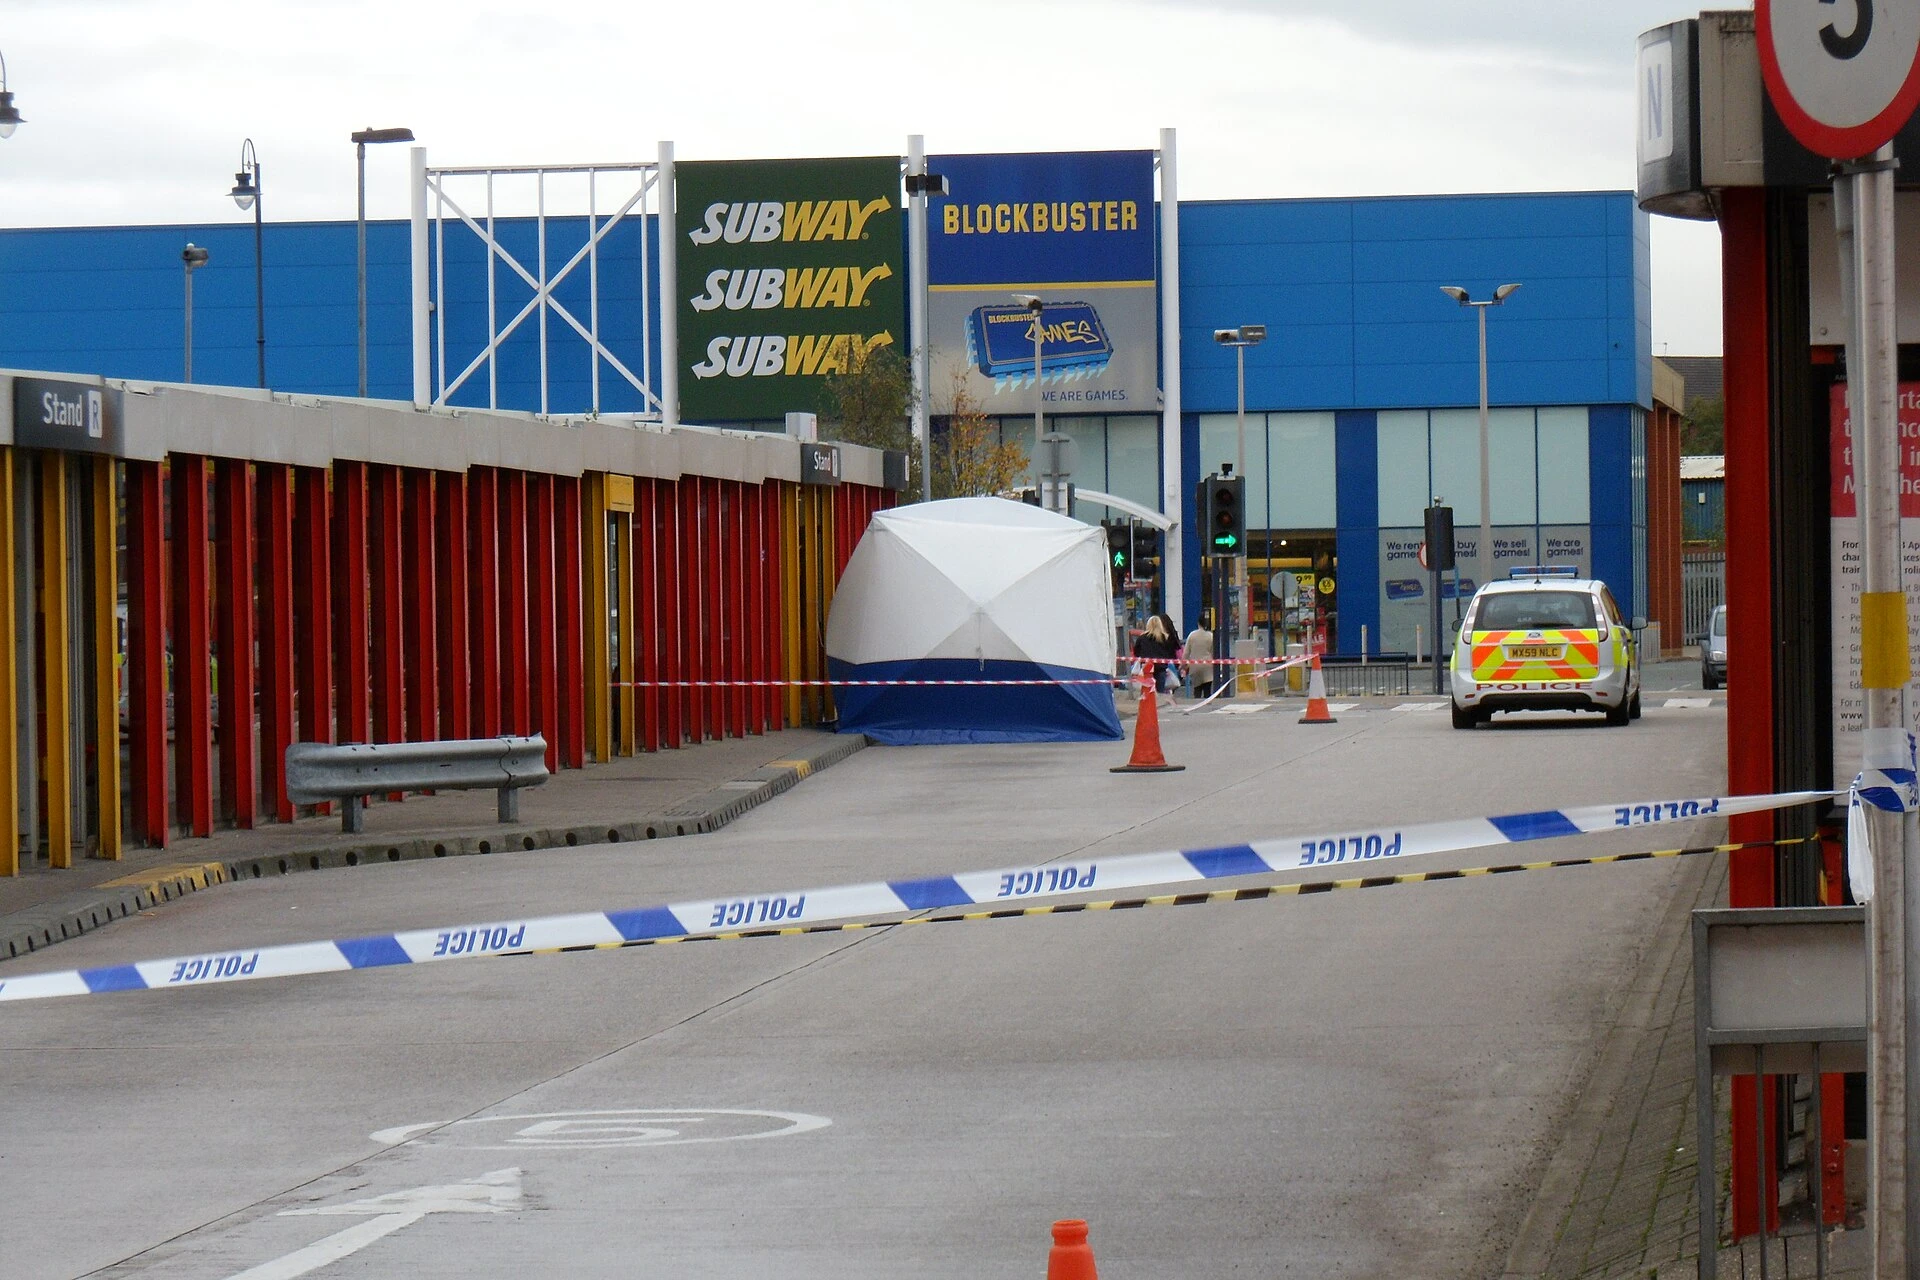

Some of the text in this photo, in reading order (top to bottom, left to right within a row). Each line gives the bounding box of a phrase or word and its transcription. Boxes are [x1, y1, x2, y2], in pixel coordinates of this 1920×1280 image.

[1648, 64, 1662, 140] N
[689, 195, 892, 247] SUBWAY
[943, 200, 1138, 234] BLOCKBUSTER
[690, 262, 893, 313] SUBWAY
[691, 329, 894, 380] SUBWAY
[43, 391, 83, 427] Stand
[1060, 391, 1082, 401] ARE
[813, 450, 831, 471] Stand
[1386, 541, 1402, 550] We
[1386, 551, 1418, 561] game
[1454, 550, 1477, 558] mes!
[1457, 541, 1477, 551] buy
[1493, 539, 1527, 548] We sell
[1546, 538, 1581, 548] We are
[1512, 647, 1558, 657] MX59 NLC
[1476, 682, 1593, 691] POLICE
[1614, 798, 1719, 826] POLICE
[1301, 832, 1401, 866] POLICE
[997, 864, 1097, 897] POLICE
[710, 896, 806, 927] POLICE
[433, 924, 526, 956] POLICE
[168, 950, 260, 983] POLICE
